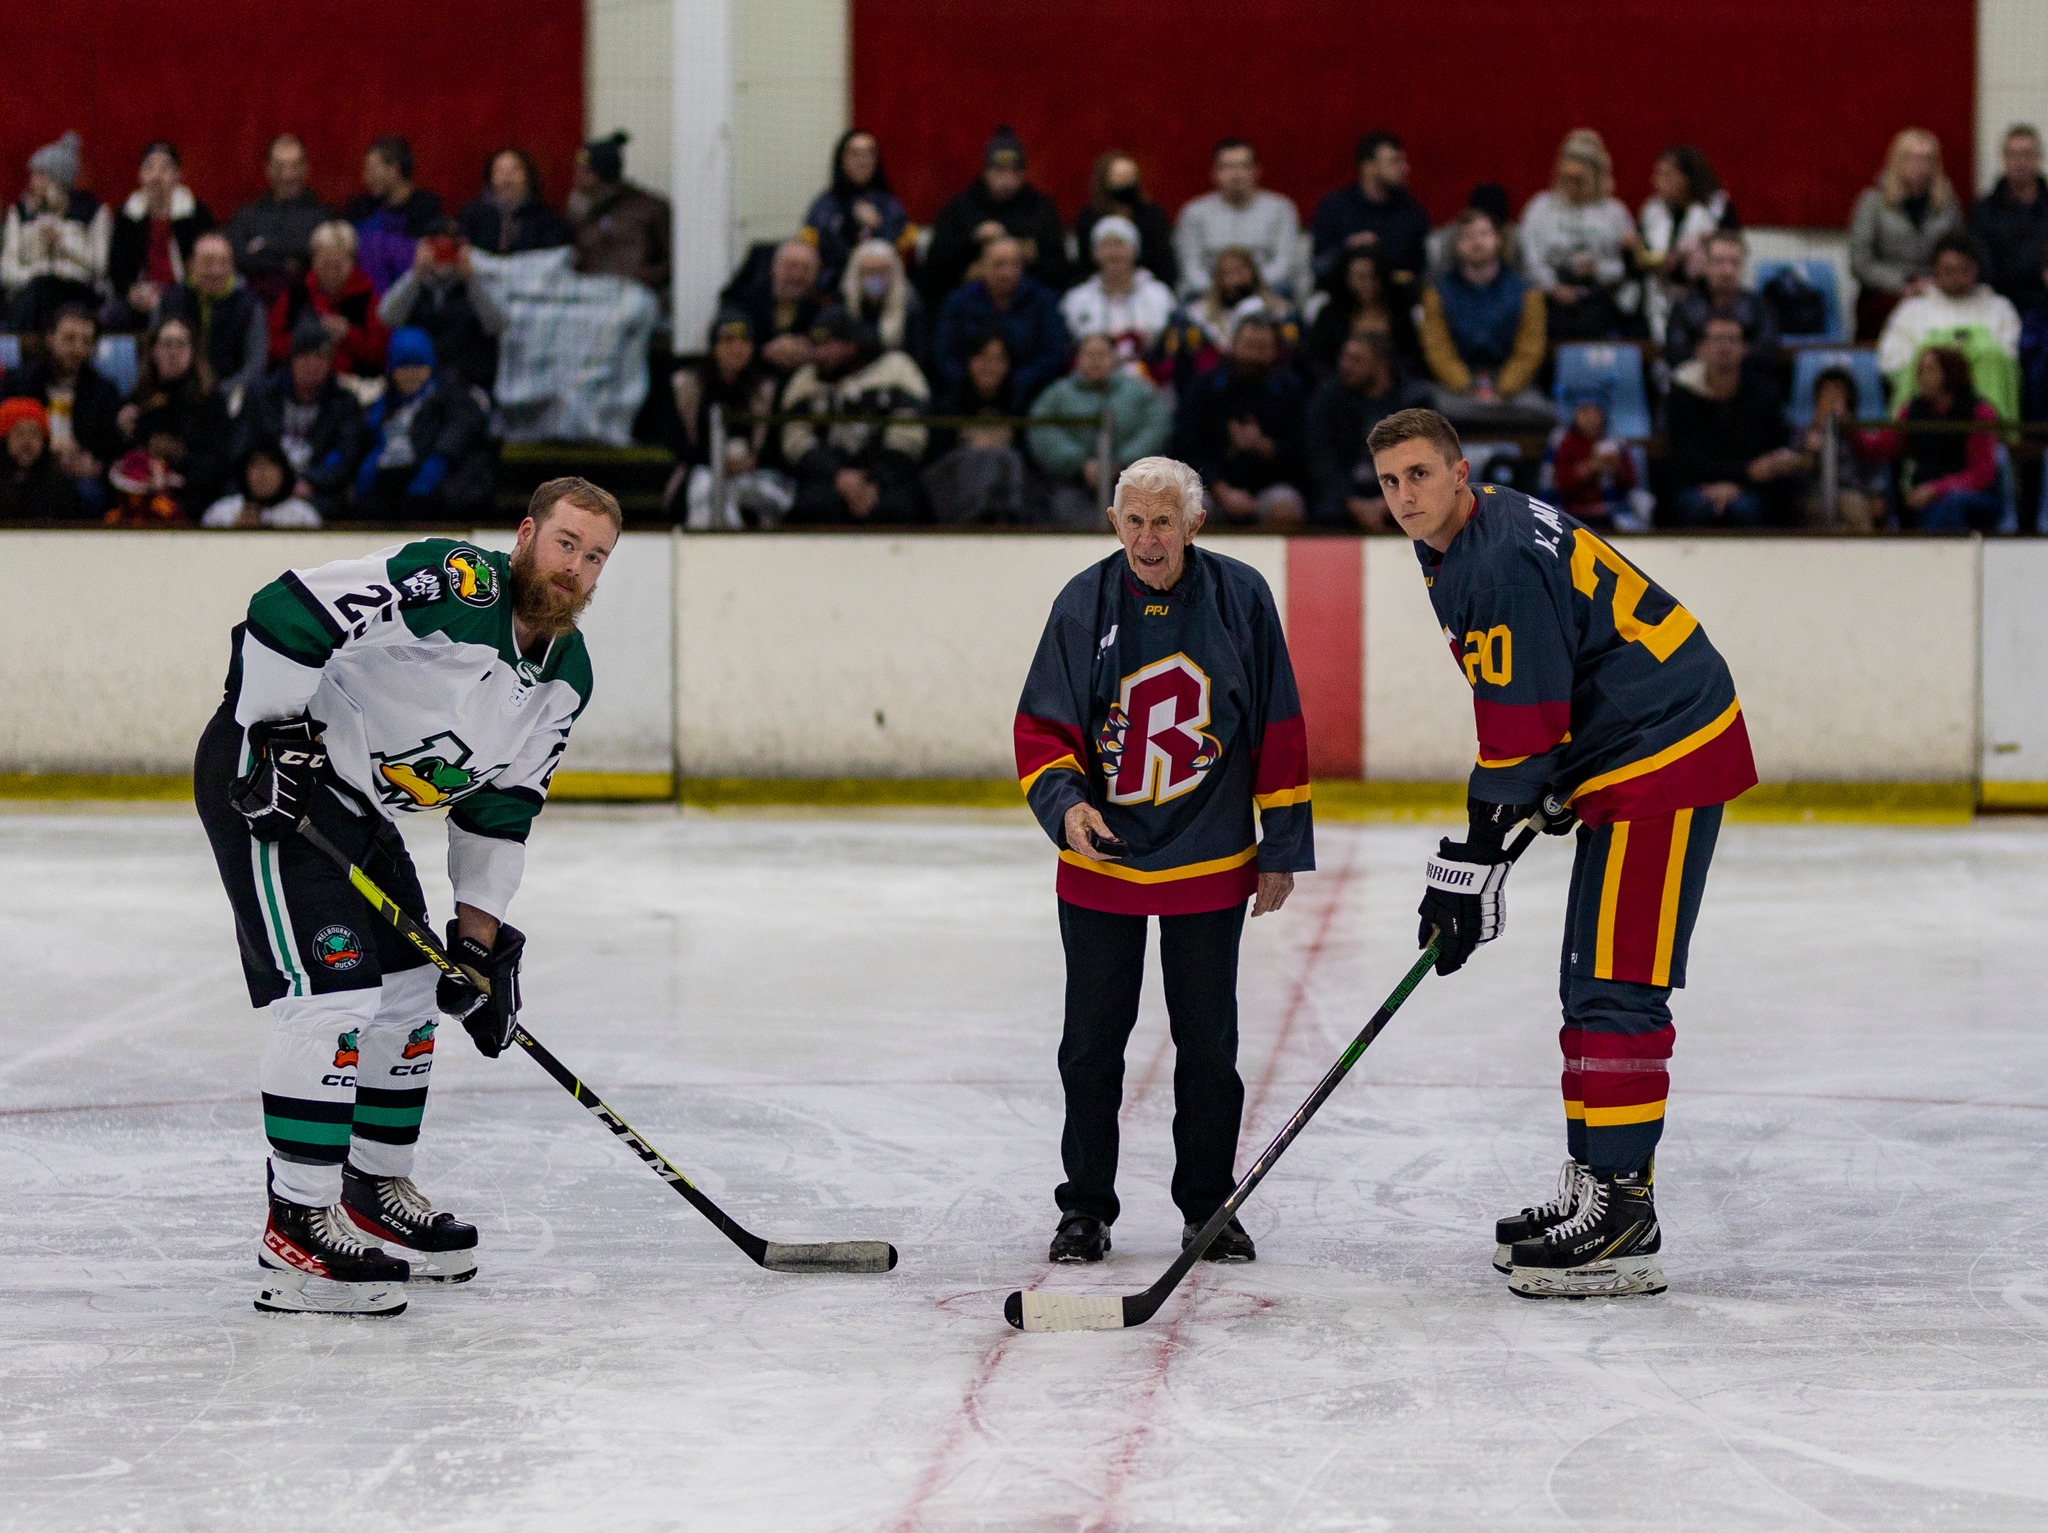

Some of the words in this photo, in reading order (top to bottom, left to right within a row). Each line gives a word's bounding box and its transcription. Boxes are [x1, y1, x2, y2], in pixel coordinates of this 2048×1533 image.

[1144, 605, 1169, 616] PPJ
[1463, 624, 1512, 687] 20
[1426, 861, 1475, 886] RRIOR
[407, 931, 450, 971] SUPER
[462, 939, 488, 958] CCM
[334, 958, 357, 969] DUCKS
[389, 1060, 433, 1077] CC
[321, 1074, 358, 1088] CC
[587, 1102, 682, 1182] CCM
[380, 1214, 413, 1236] CCM
[264, 1229, 327, 1277] CCM
[1573, 1235, 1605, 1255] CCM
